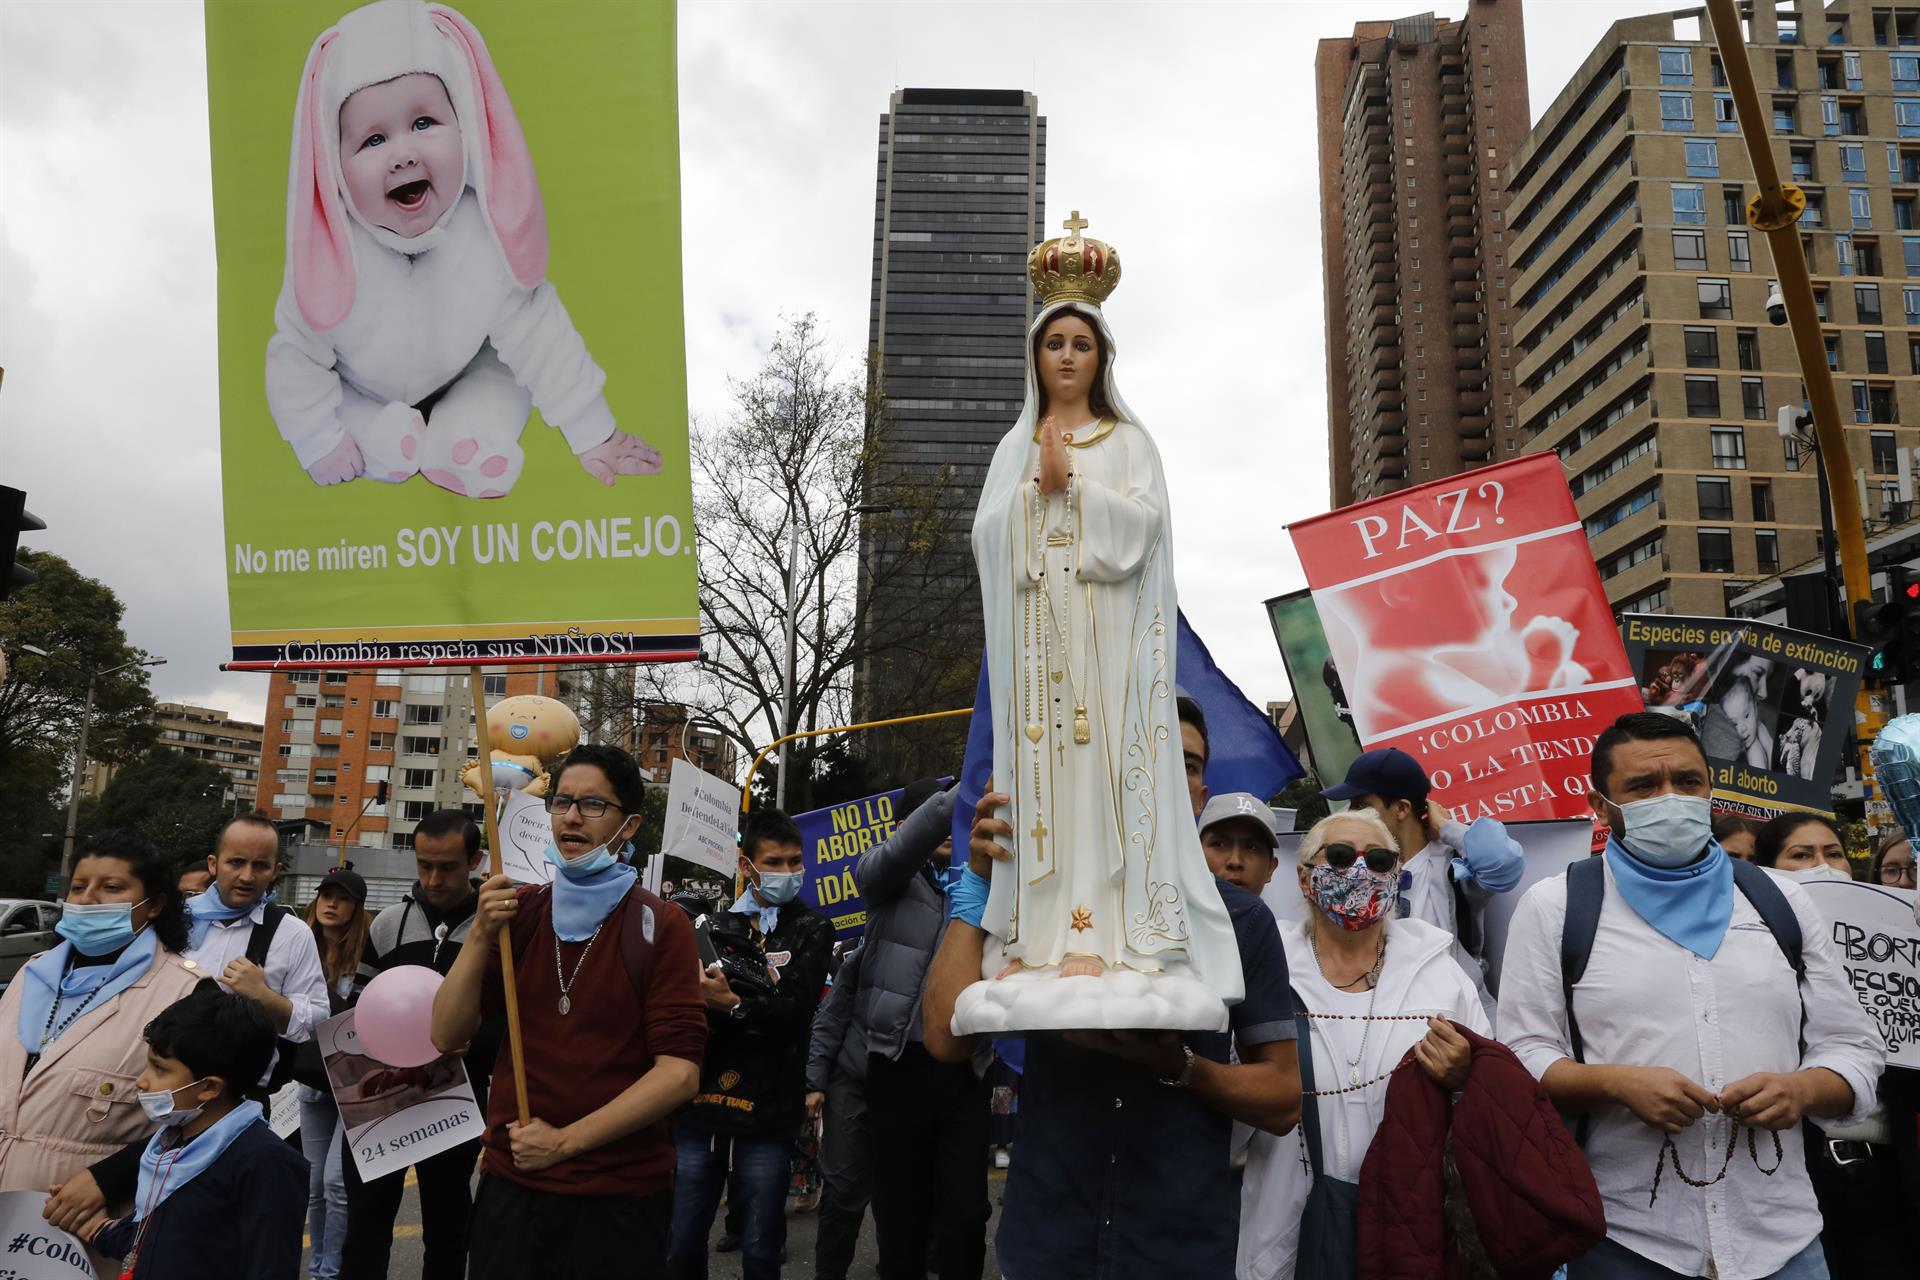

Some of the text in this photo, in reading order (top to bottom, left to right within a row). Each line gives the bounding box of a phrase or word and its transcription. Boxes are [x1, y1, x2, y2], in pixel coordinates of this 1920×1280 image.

[1351, 480, 1505, 560] PAZ?
[235, 514, 692, 574] No me miren SOY UN CONEJO.
[273, 626, 636, 668] ¡Colombia respeta sus NIÑOS!
[1628, 620, 1705, 647] Especies
[1710, 628, 1733, 645] en
[1762, 632, 1782, 654] de
[1785, 640, 1858, 673] extinción
[1417, 699, 1593, 754] ¡COLOMBIA
[1430, 734, 1599, 790] O LA TEND
[1719, 765, 1734, 785] al
[1737, 769, 1778, 795] aborto
[831, 796, 894, 834] NO LO
[1236, 796, 1256, 814] LA
[1449, 779, 1558, 824] HASTA
[1711, 798, 1745, 814] espeta
[1747, 804, 1762, 817] sus
[833, 912, 858, 929] ación
[1833, 921, 1920, 968] ABORT
[361, 1109, 471, 1164] 24 semanas
